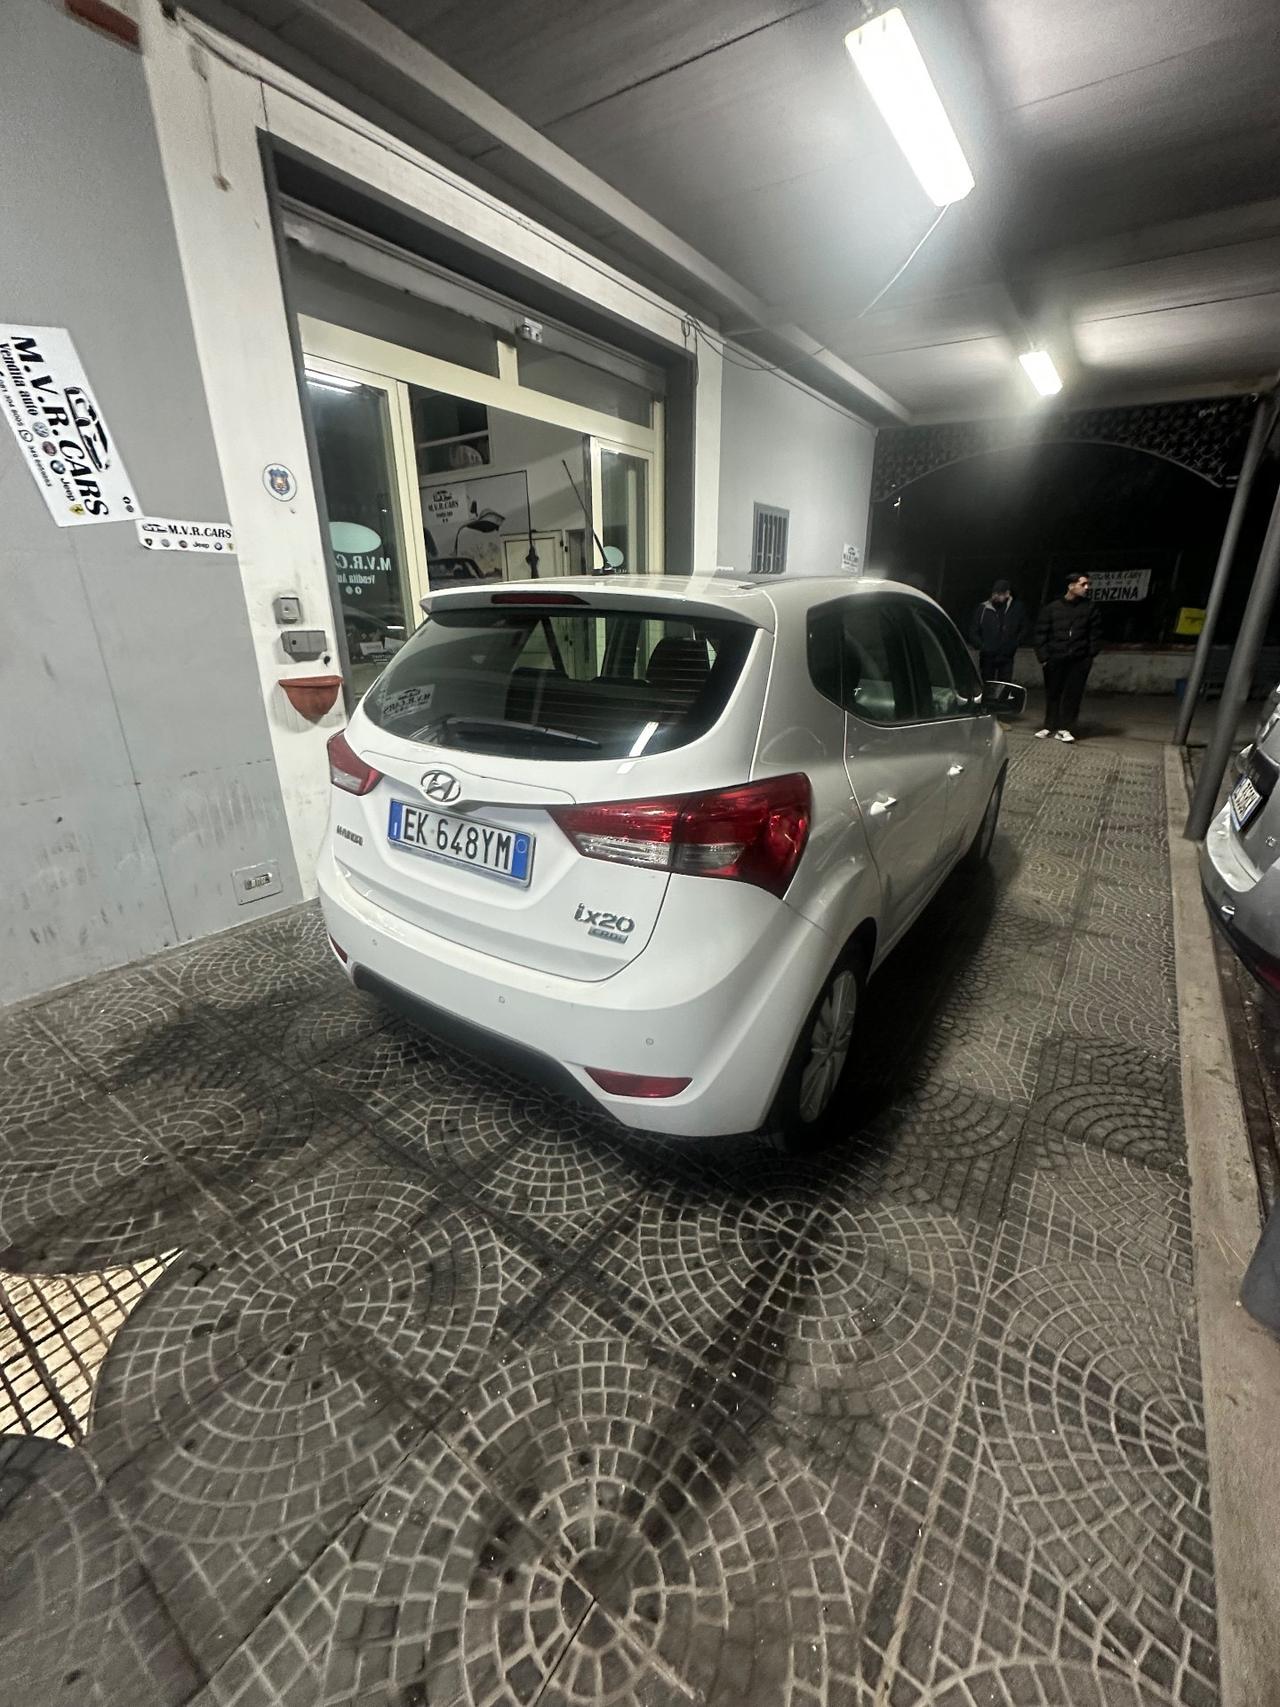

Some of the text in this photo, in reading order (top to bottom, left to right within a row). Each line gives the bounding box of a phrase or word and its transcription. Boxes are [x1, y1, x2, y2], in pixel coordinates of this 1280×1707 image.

[19, 391, 39, 415] auto
[60, 478, 76, 501] Jeep
[168, 525, 232, 538] M.V.R.CARS
[403, 808, 512, 870] EK 648YM
[574, 902, 636, 933] ix20
